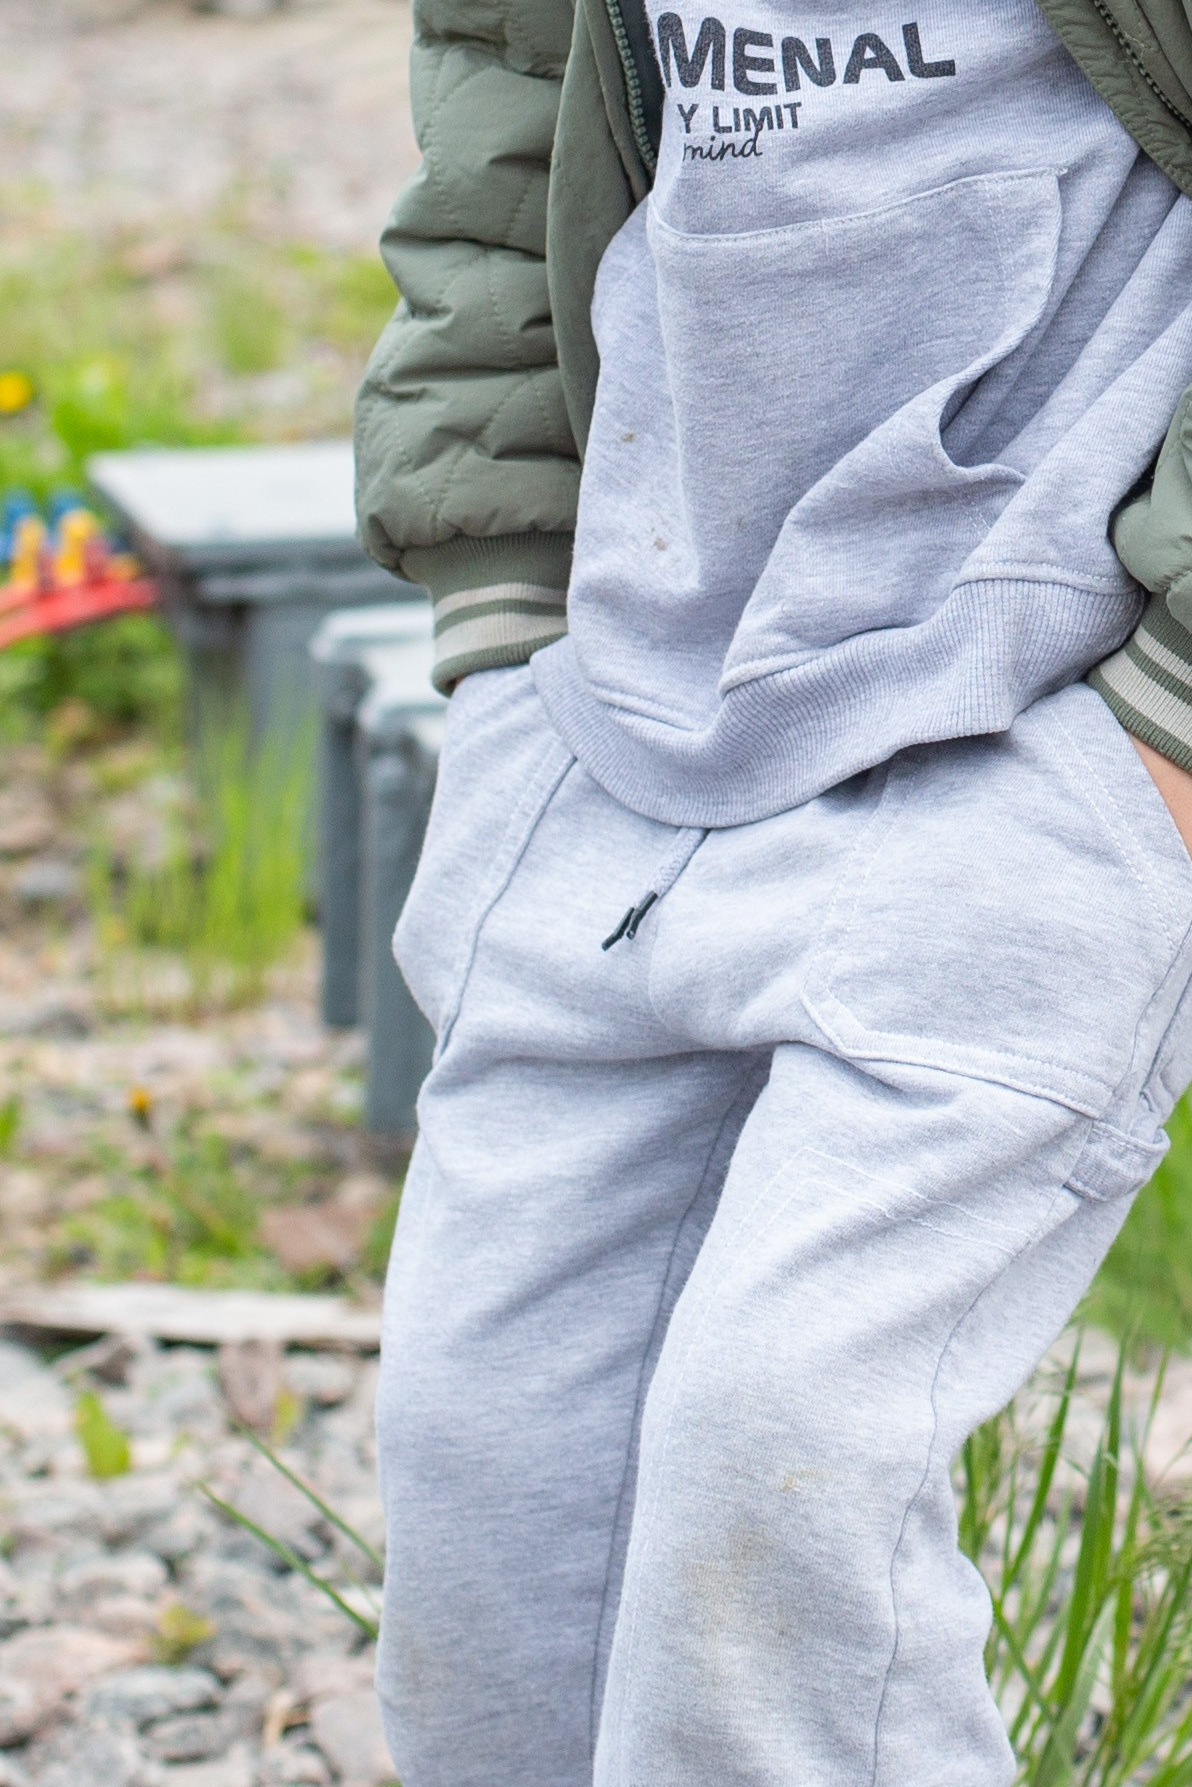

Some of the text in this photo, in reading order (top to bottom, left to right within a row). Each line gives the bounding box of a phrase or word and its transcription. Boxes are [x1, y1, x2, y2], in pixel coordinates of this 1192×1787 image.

[657, 12, 956, 96] MENAL
[712, 101, 802, 134] LIMIT
[682, 126, 763, 162] mind
